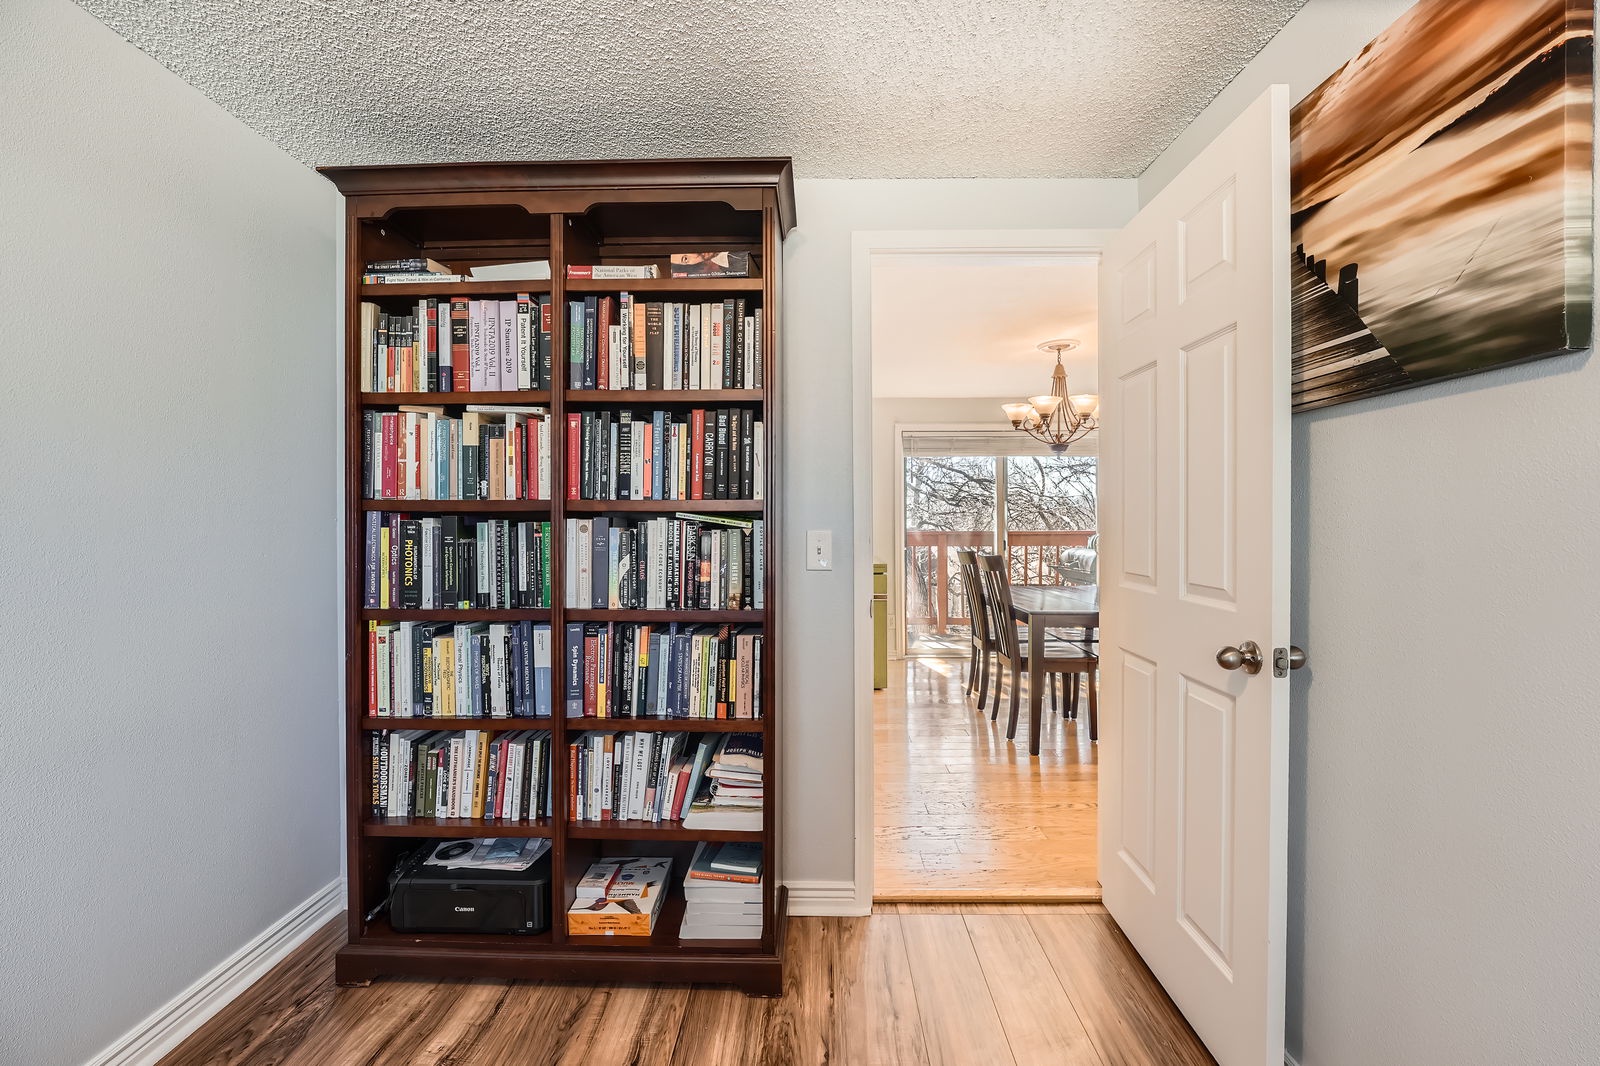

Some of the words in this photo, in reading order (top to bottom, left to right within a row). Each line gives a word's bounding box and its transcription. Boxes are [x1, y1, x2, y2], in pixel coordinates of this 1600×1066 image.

[505, 319, 511, 327] IP
[737, 332, 743, 342] GO
[737, 344, 742, 354] UP
[719, 415, 727, 427] Bad
[705, 432, 714, 455] CARRY
[718, 427, 727, 445] Blood
[705, 456, 713, 466] ON
[390, 545, 399, 566] Optics
[404, 539, 413, 586] PHOTONICS
[571, 659, 579, 686] Dynamics
[380, 751, 388, 805] OUTDOORSMAN
